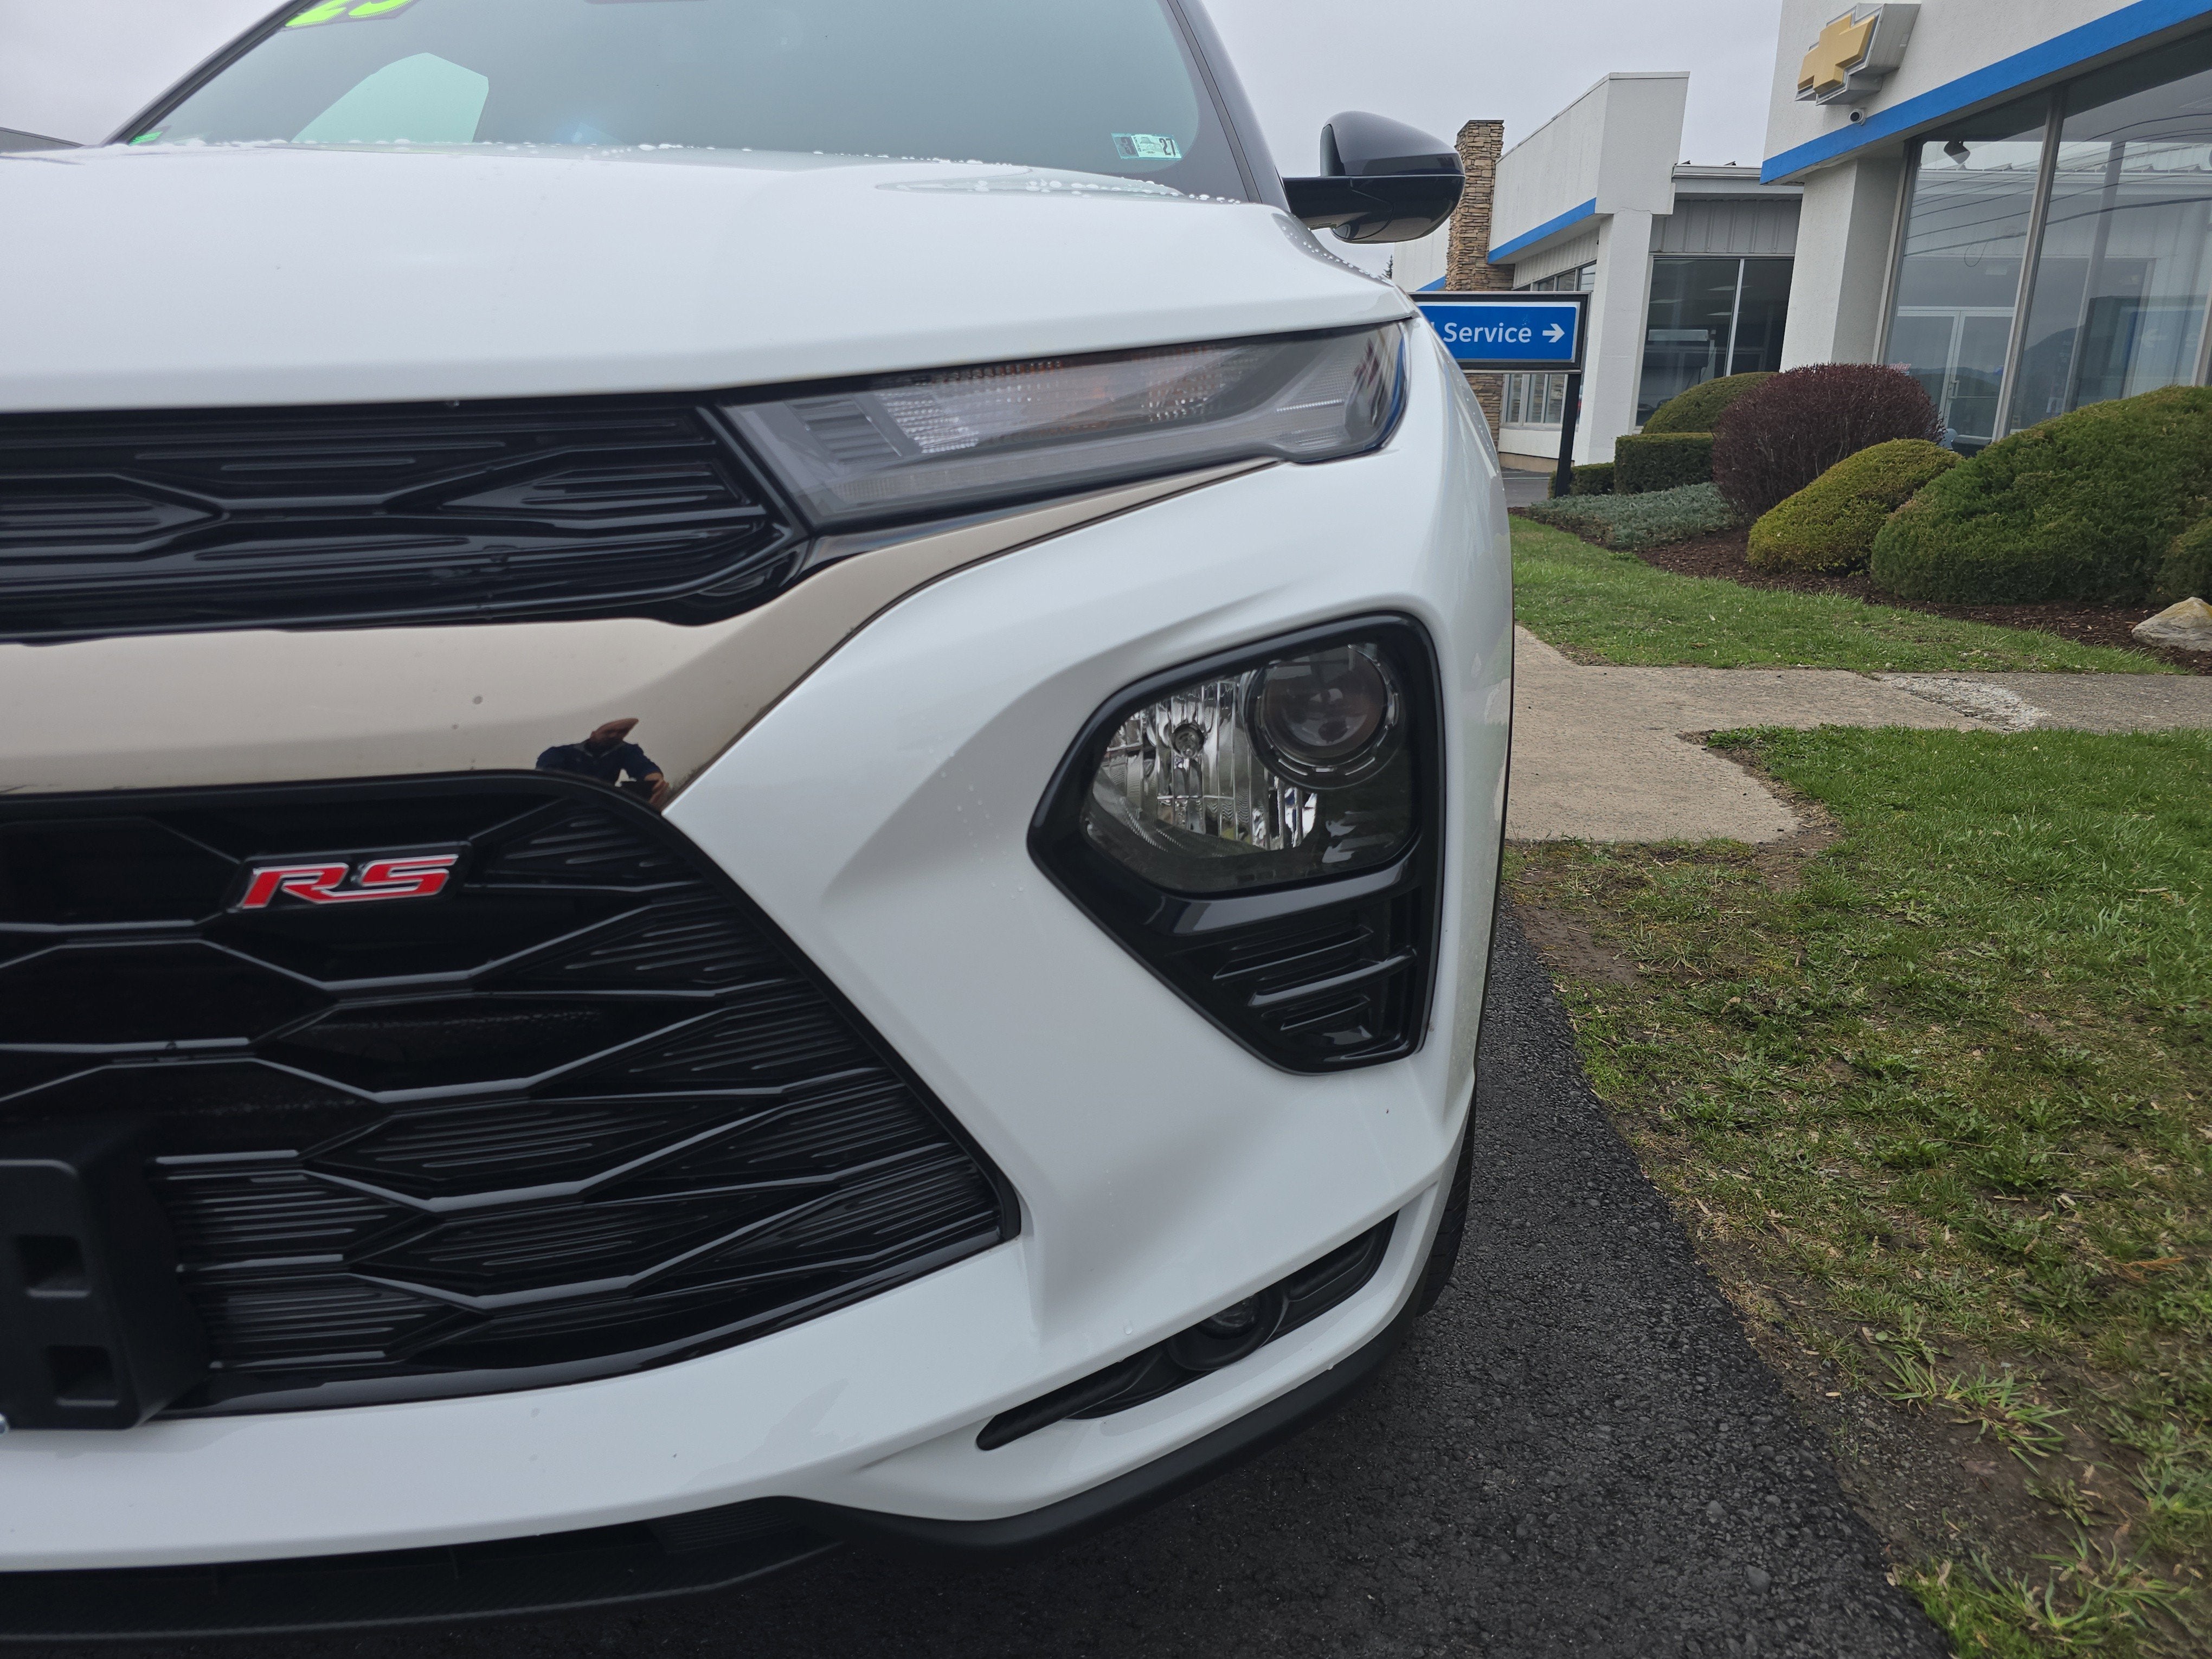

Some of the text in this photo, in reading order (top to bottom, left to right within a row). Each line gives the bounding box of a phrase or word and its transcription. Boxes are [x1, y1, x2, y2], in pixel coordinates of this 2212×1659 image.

[1159, 138, 1176, 156] 27
[1443, 322, 1532, 343] Service
[242, 854, 459, 909] RS
